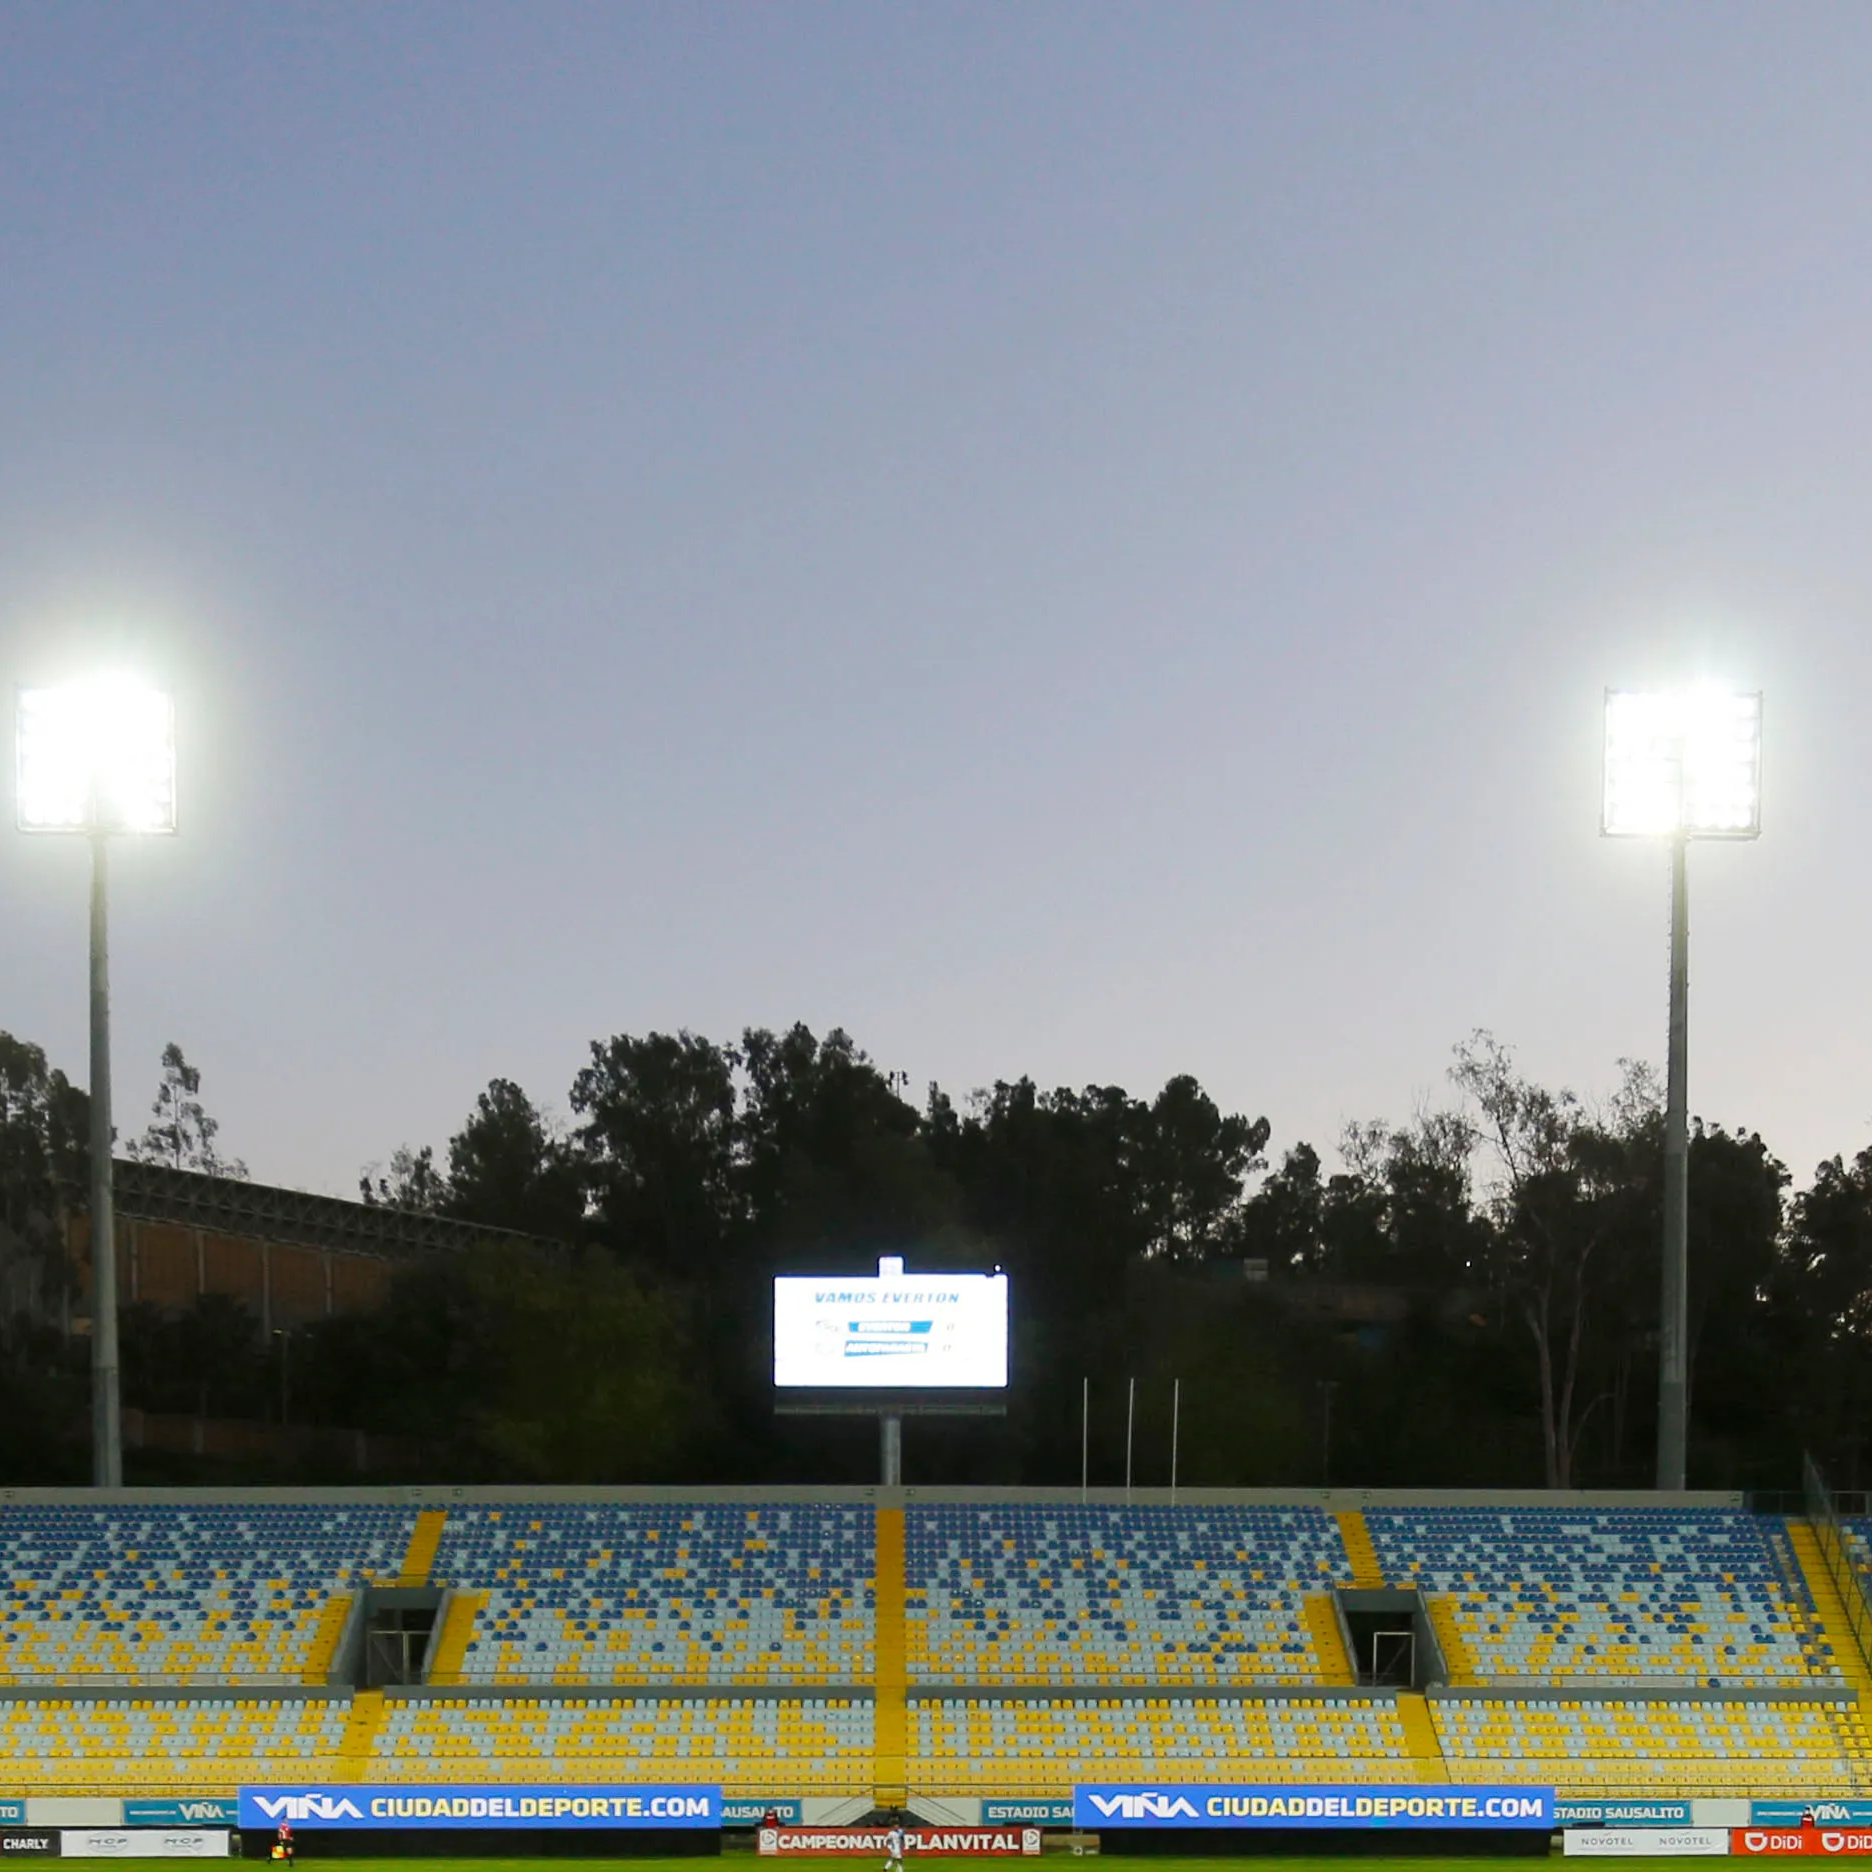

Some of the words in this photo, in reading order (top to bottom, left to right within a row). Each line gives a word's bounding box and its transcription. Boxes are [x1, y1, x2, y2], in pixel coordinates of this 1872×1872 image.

[815, 1292, 876, 1303] VAMOS
[178, 1802, 225, 1820] VIÑA
[252, 1793, 366, 1819] VIÑA
[370, 1796, 710, 1818] CIUDADDELDEPORTE.COM
[1088, 1792, 1200, 1818] VIÑA
[1206, 1796, 1543, 1818] CIUDADDELDEPORTE.COM
[987, 1806, 1049, 1819] ESTADIO
[1605, 1806, 1684, 1819] SAUSALITO
[2, 1838, 49, 1850] CHARLY
[88, 1837, 128, 1847] MCP
[164, 1837, 204, 1846] MCP
[904, 1834, 1019, 1850] PLANVITAL
[1581, 1837, 1634, 1847] NOVOTEL
[1659, 1837, 1712, 1846] NOVOTEL
[1770, 1834, 1802, 1850] DiDi
